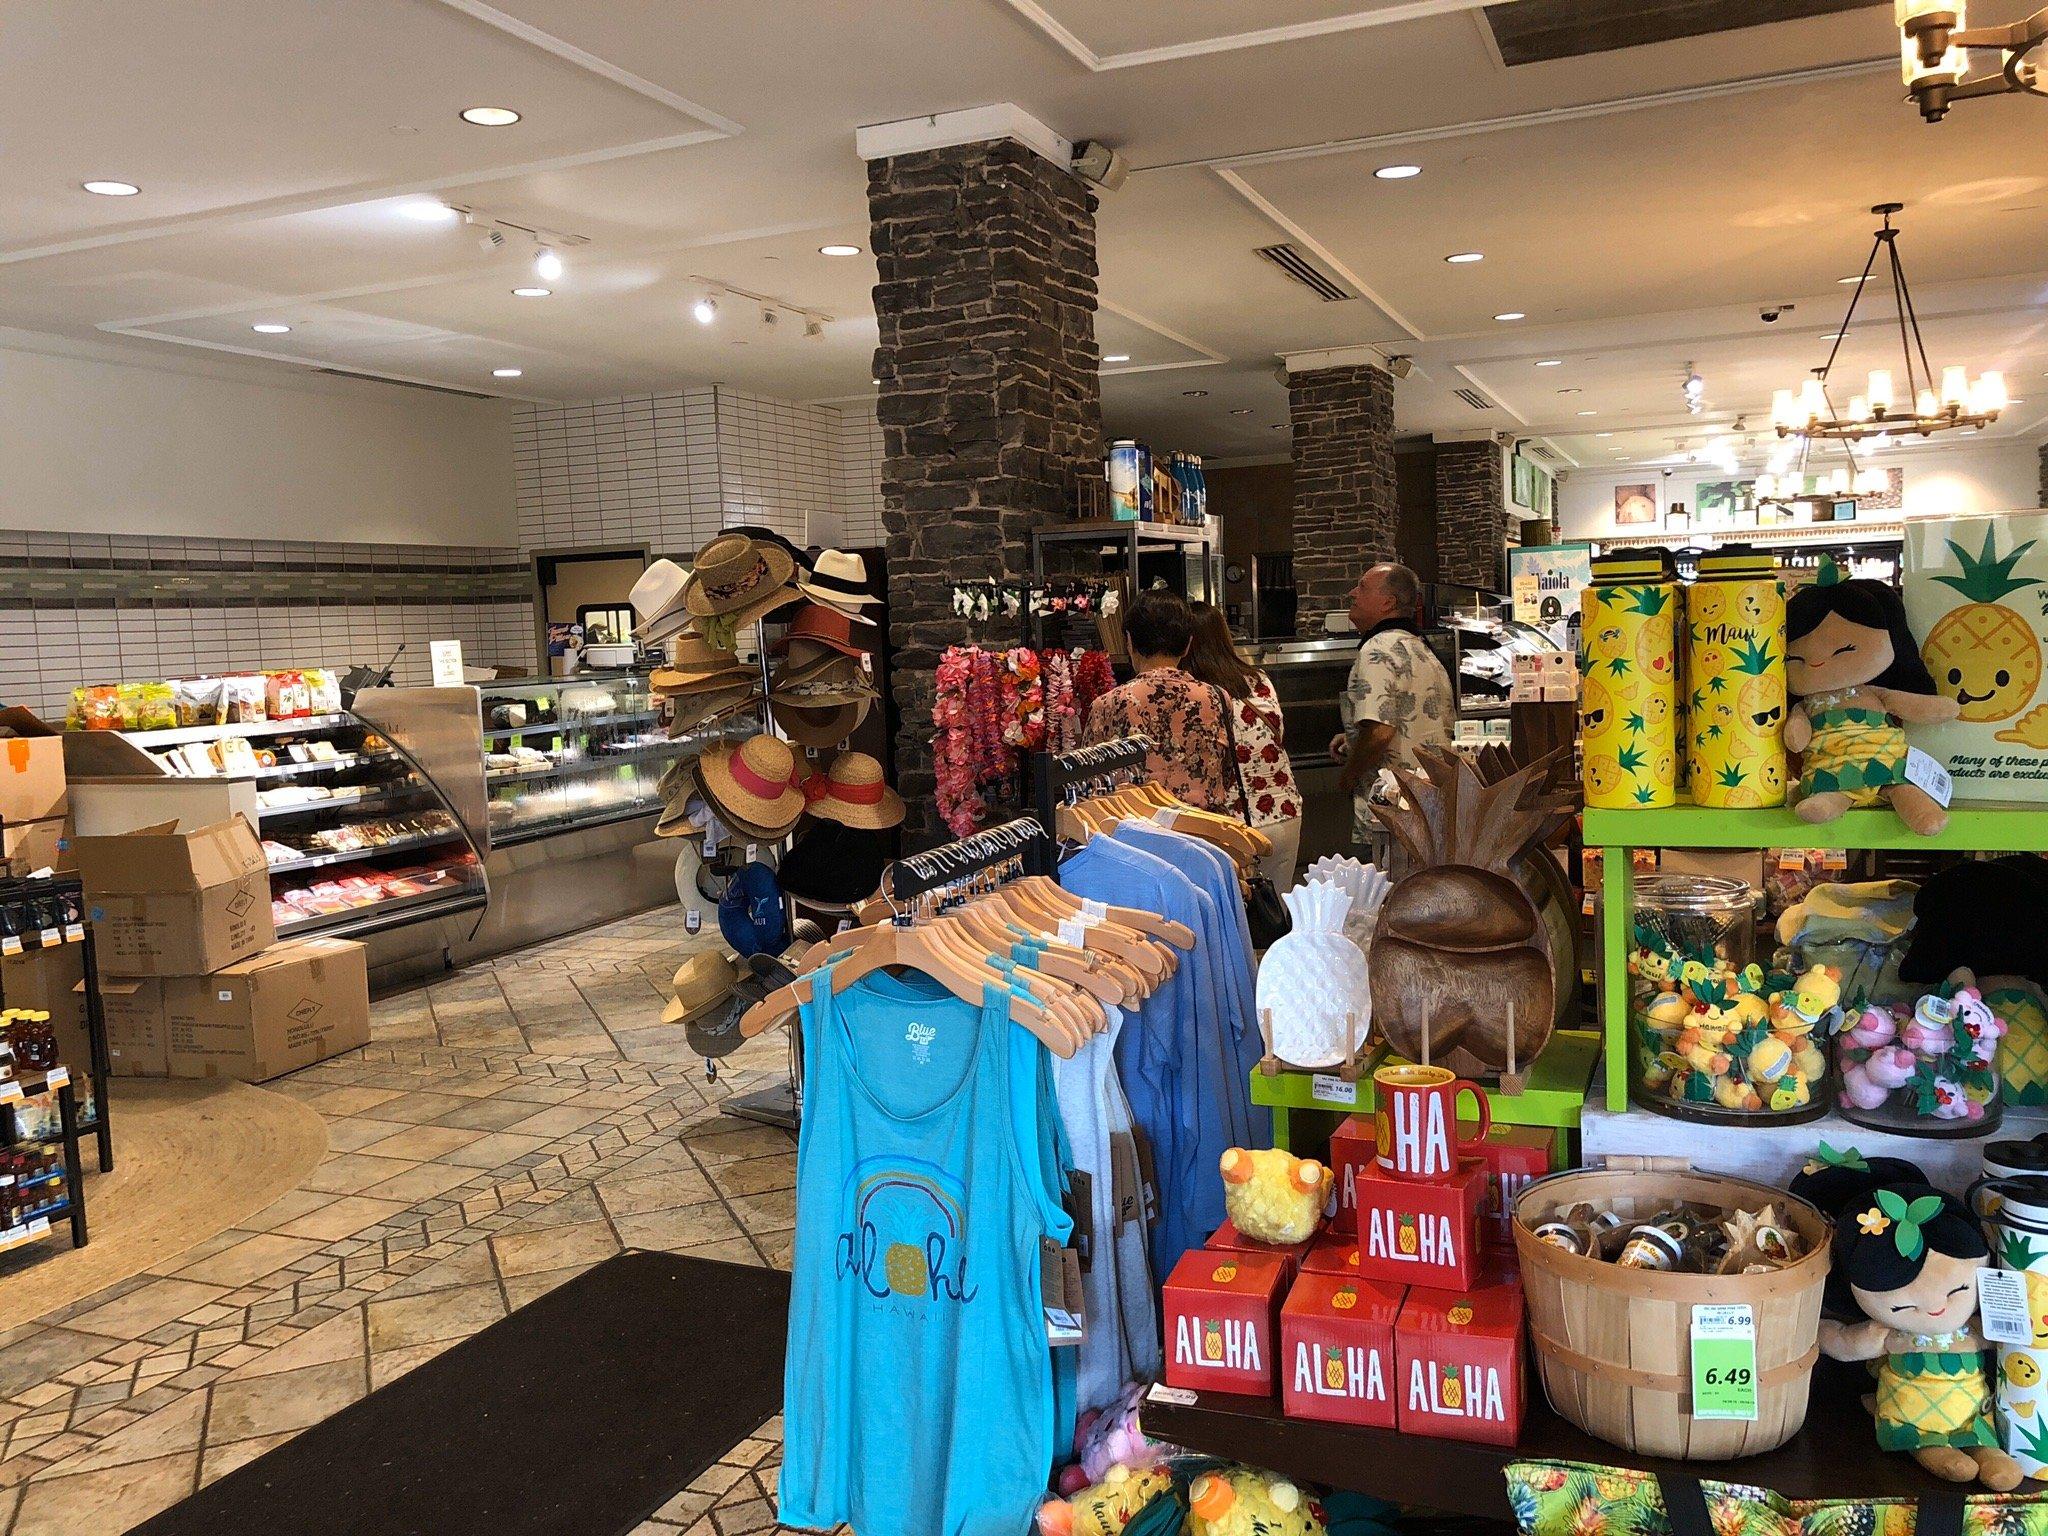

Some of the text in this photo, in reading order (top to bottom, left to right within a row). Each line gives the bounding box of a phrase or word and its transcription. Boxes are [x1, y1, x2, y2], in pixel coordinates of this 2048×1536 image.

[1703, 623, 1759, 645] Maui
[1949, 754, 1987, 767] Many
[1989, 756, 2004, 768] of
[2005, 756, 2038, 766] these
[1947, 767, 1986, 778] oducts
[1988, 770, 2010, 778] are
[904, 1022, 937, 1042] Blue
[1369, 1207, 1456, 1267] ALOHA
[872, 1304, 947, 1322] HAWAII
[1728, 1316, 1751, 1325] 6.99
[1175, 1315, 1261, 1371] ALOHA
[1294, 1341, 1386, 1401] ALOHA
[1705, 1367, 1751, 1385] 6.49
[1409, 1358, 1505, 1421] ALOHA
